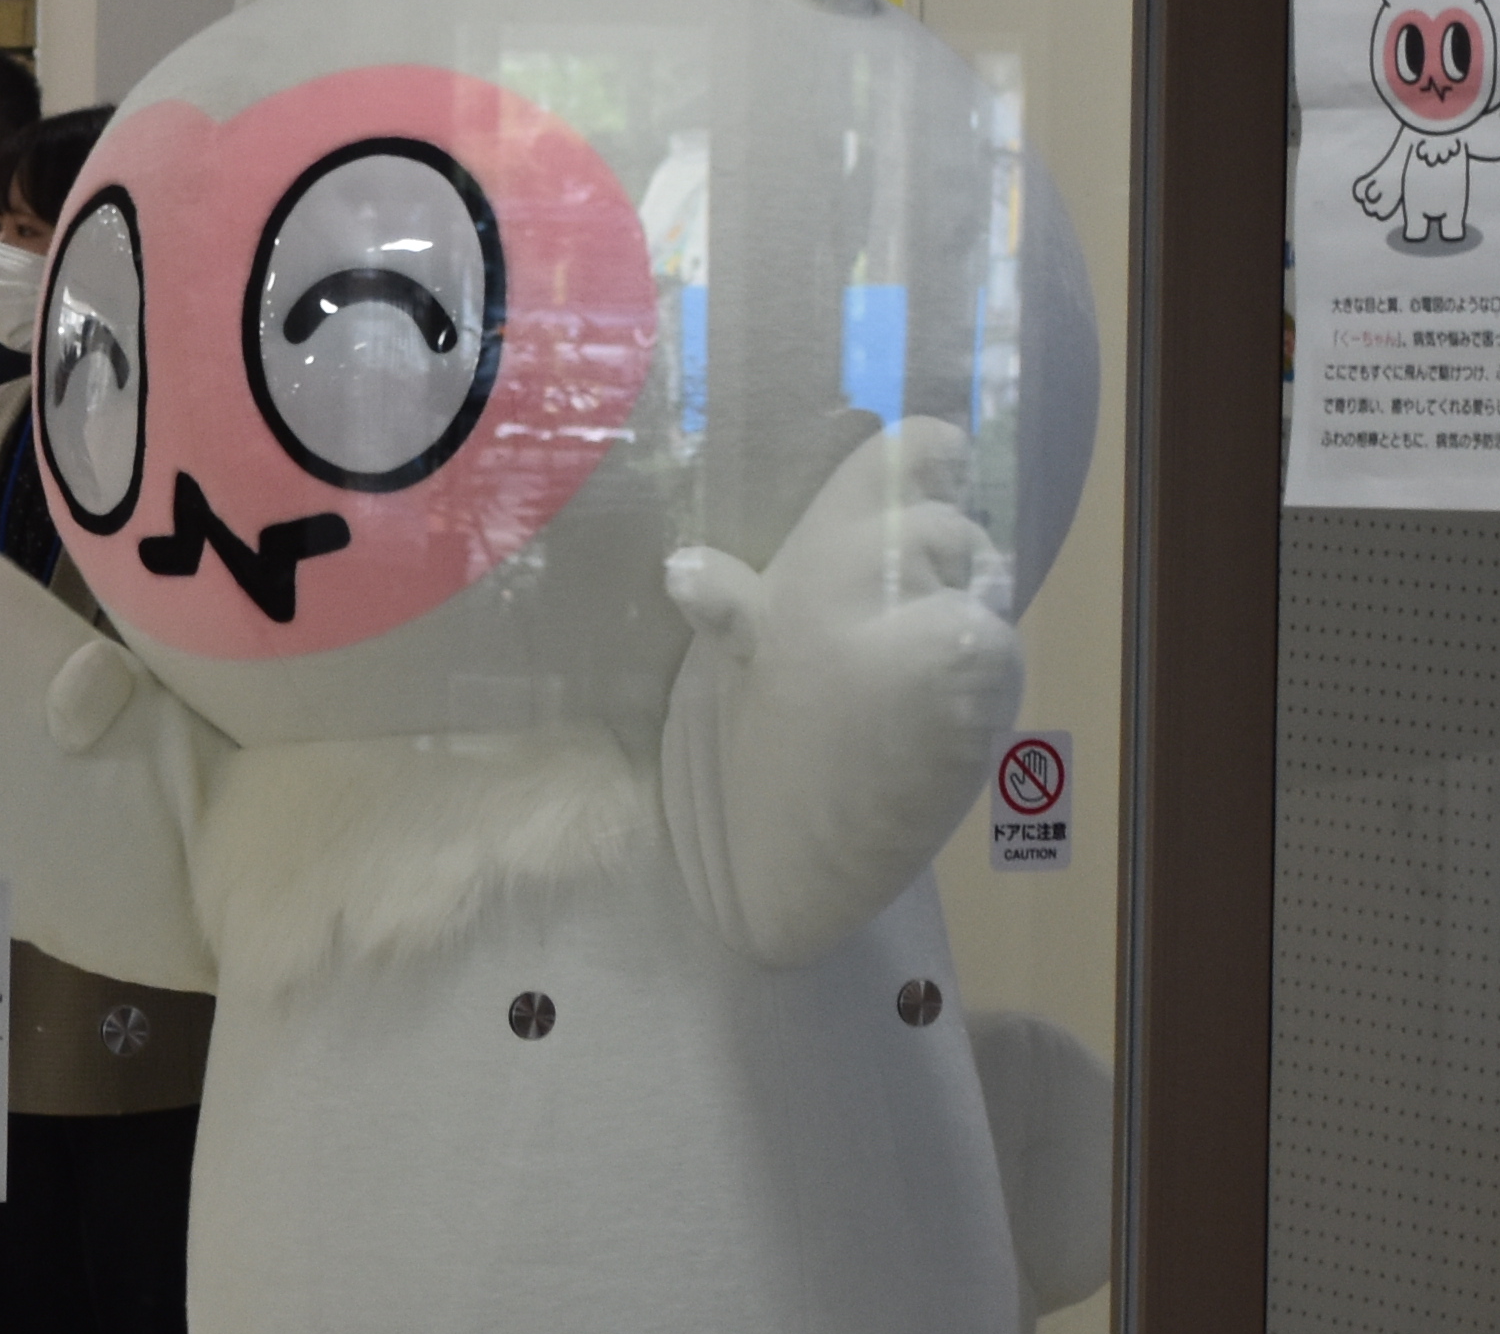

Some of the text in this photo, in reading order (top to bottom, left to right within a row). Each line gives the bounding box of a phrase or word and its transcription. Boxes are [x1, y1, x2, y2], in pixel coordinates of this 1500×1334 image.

[994, 821, 1067, 842] ドアに注意
[1004, 848, 1058, 861] CAUTION
